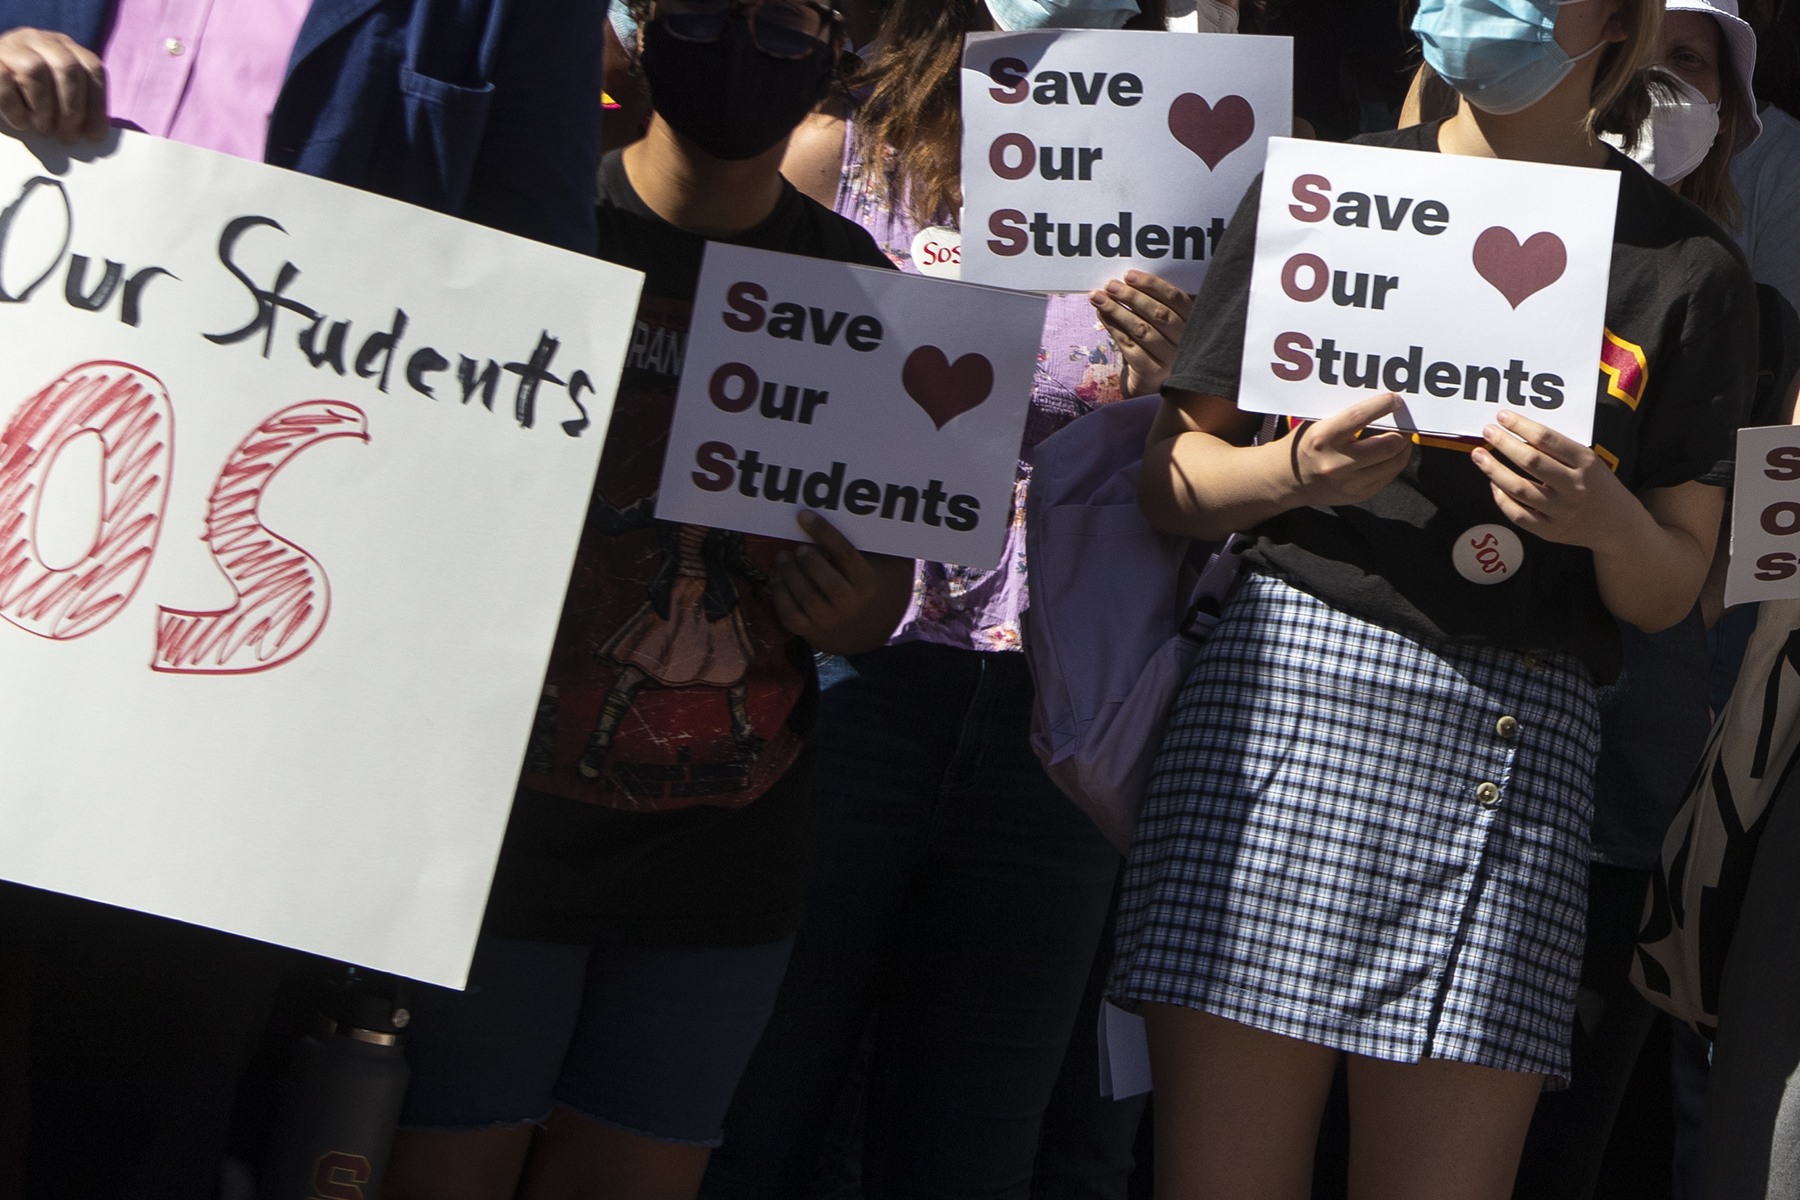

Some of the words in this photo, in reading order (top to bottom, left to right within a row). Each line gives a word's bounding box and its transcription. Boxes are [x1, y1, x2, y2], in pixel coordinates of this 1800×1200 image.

[987, 57, 1143, 106] Save
[988, 132, 1101, 181] Our
[986, 208, 1226, 260] Student
[1288, 173, 1449, 235] Save
[0, 176, 182, 327] Our
[200, 215, 597, 437] Students
[1280, 252, 1399, 310] Our
[722, 281, 884, 352] Save
[708, 361, 828, 425] Our
[1270, 331, 1565, 410] Students
[691, 441, 980, 532] Students
